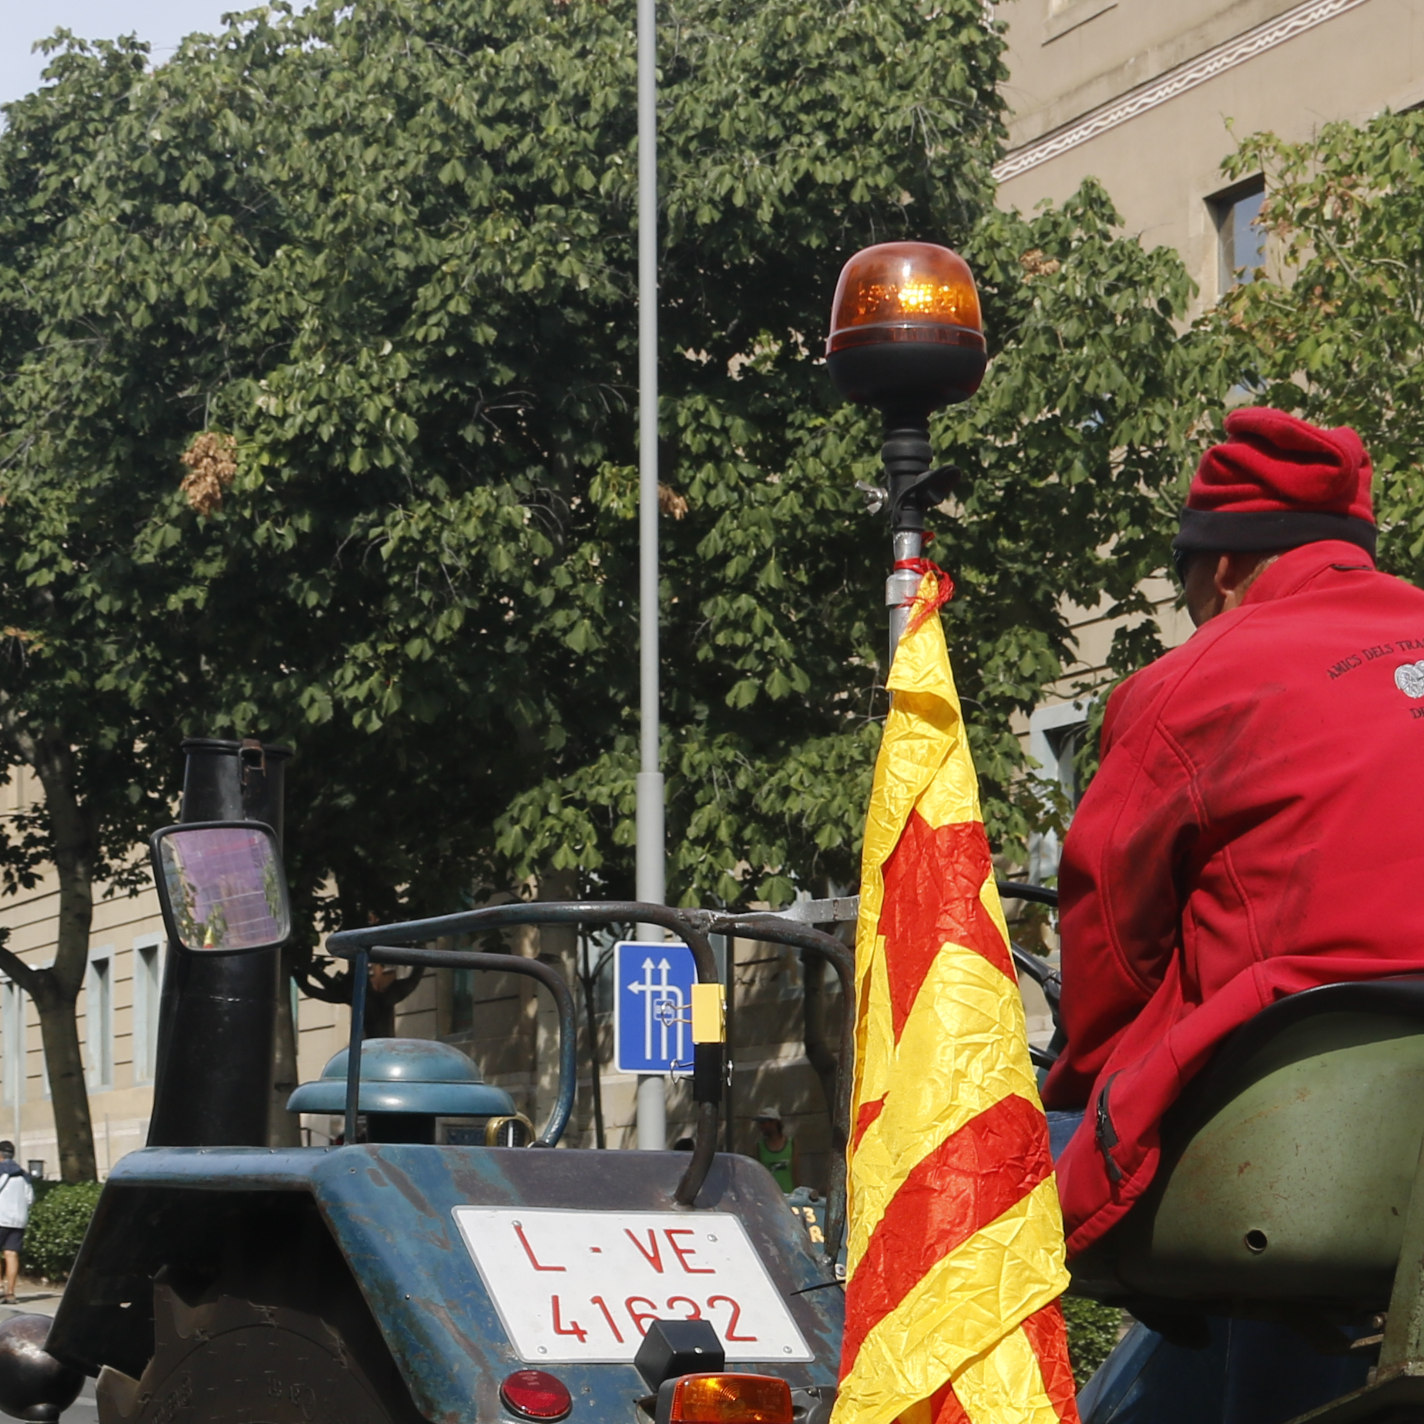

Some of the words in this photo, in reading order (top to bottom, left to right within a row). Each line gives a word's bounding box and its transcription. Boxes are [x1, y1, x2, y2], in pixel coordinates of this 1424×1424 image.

[1327, 655, 1362, 680] AMICS
[1362, 643, 1394, 662] DELS
[515, 1221, 567, 1272] L
[624, 1229, 716, 1274] VE
